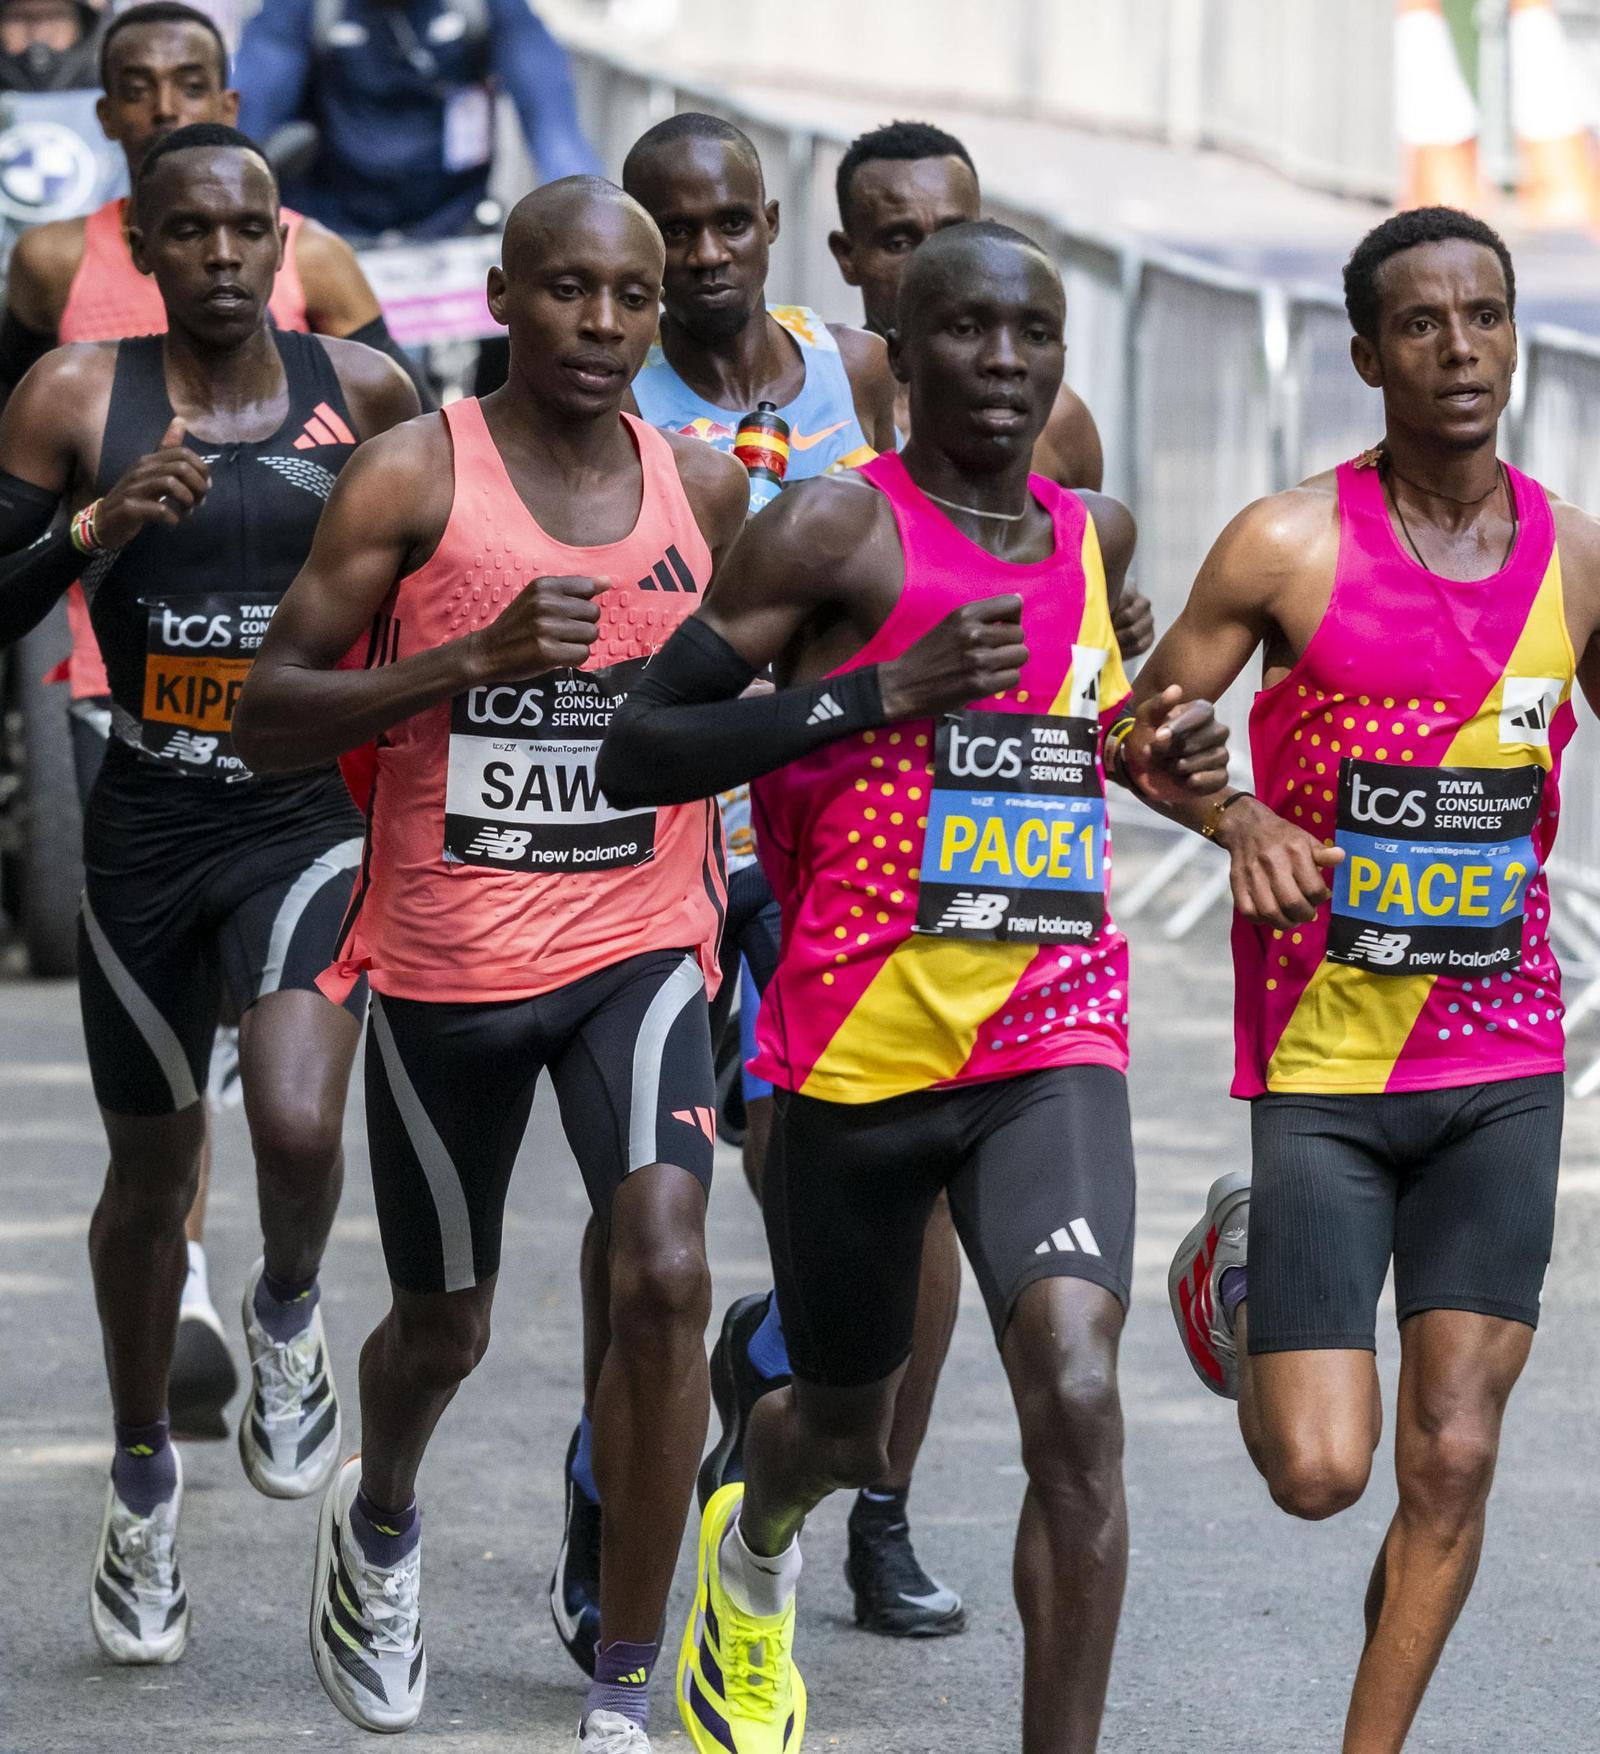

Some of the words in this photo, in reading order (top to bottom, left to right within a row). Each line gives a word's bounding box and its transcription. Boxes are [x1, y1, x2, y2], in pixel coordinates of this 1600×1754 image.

[163, 609, 232, 648] tcs
[555, 680, 600, 694] TATA
[467, 686, 545, 727] tcs
[1031, 728, 1069, 745] TATA
[948, 725, 1023, 778] tcs
[1030, 765, 1083, 783] SERVICES
[1437, 780, 1484, 794] TATA
[1350, 774, 1427, 828] tcs
[1435, 796, 1533, 813] CONSULTANCY
[1434, 815, 1502, 830] SERVICES
[531, 849, 571, 864] new
[572, 842, 638, 864] balance
[1347, 855, 1492, 917] PACE
[1500, 861, 1527, 914] 2
[1007, 917, 1038, 933] new
[1038, 915, 1093, 937] balance
[1409, 951, 1447, 966] new
[1449, 947, 1511, 968] balance
